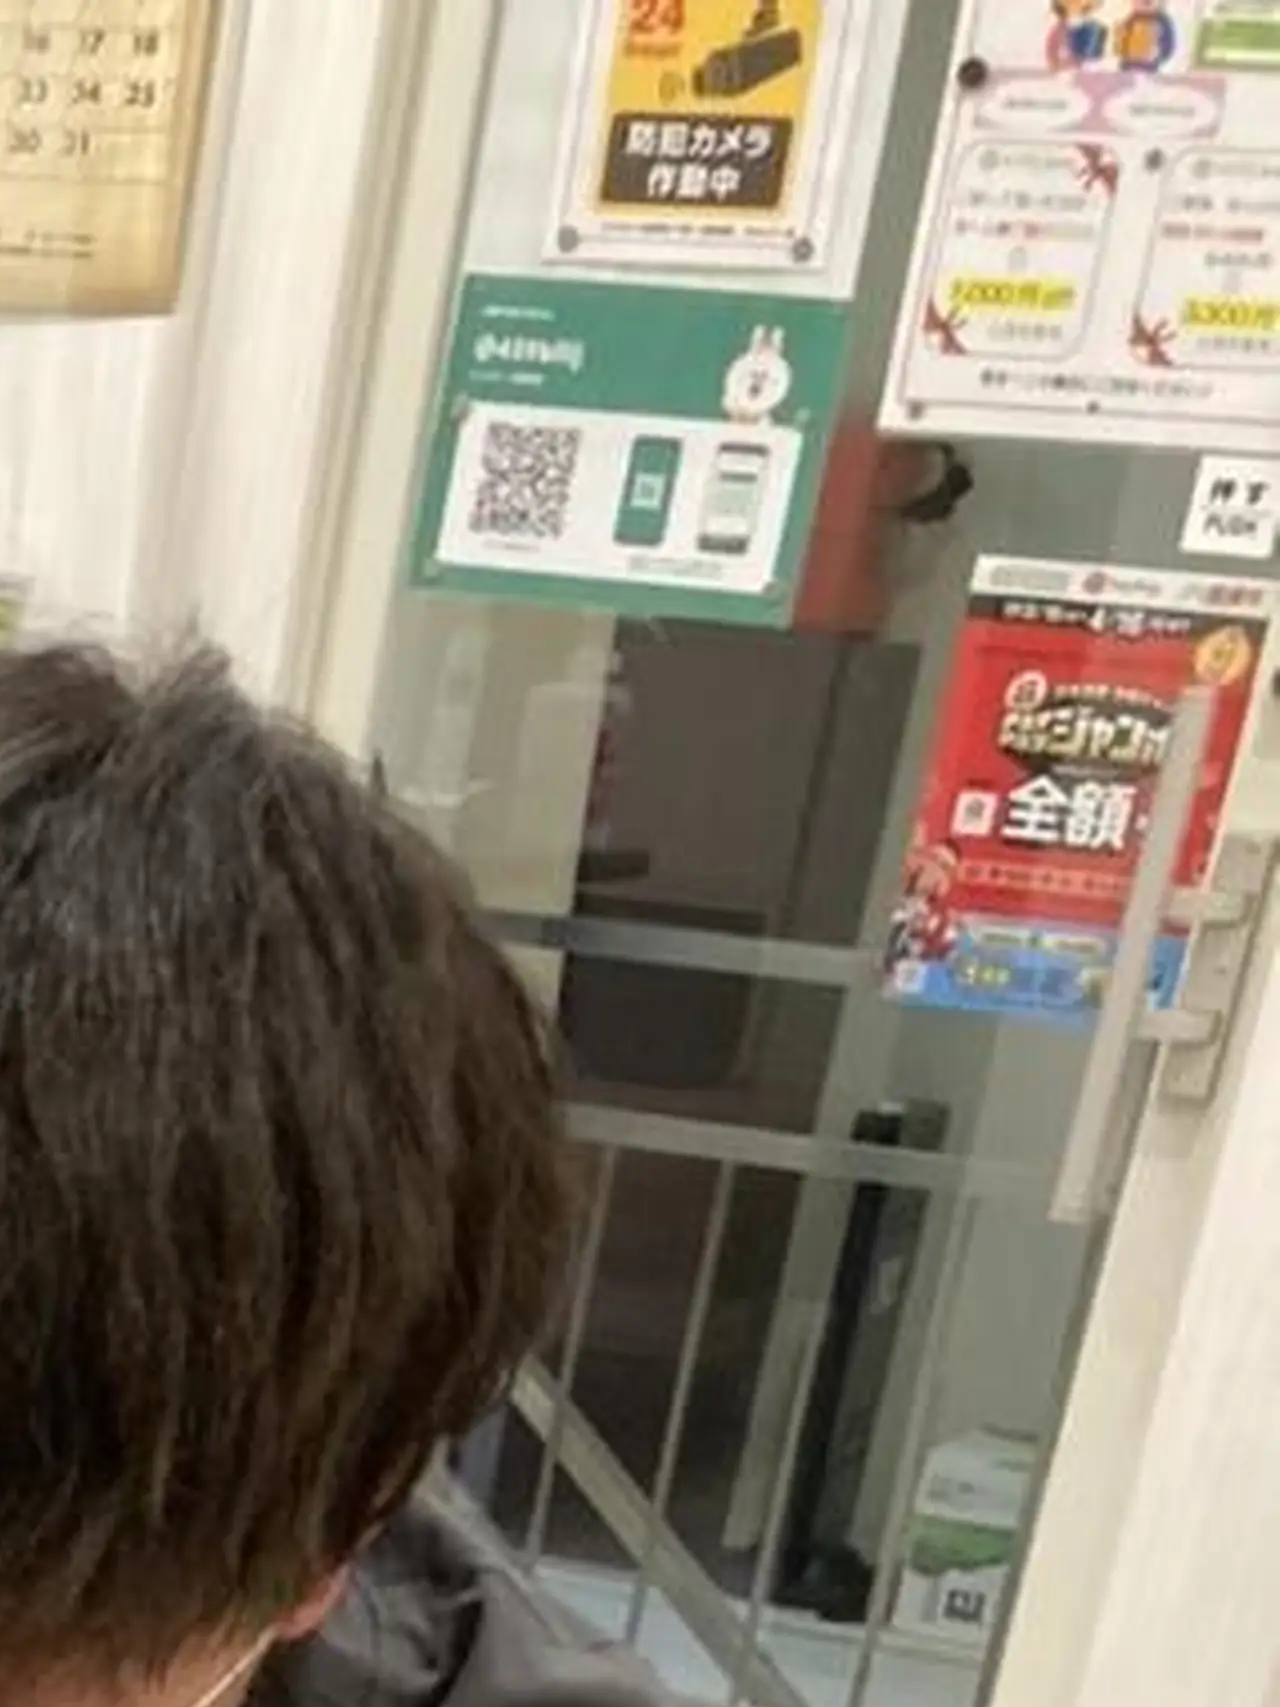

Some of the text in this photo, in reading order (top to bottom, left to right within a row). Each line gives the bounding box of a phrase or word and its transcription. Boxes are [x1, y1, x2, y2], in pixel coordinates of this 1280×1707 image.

[80, 28, 106, 55] 17
[626, 120, 773, 159] 防犯カメラ
[646, 163, 741, 202] 作動中
[1001, 776, 1137, 849] 全額
